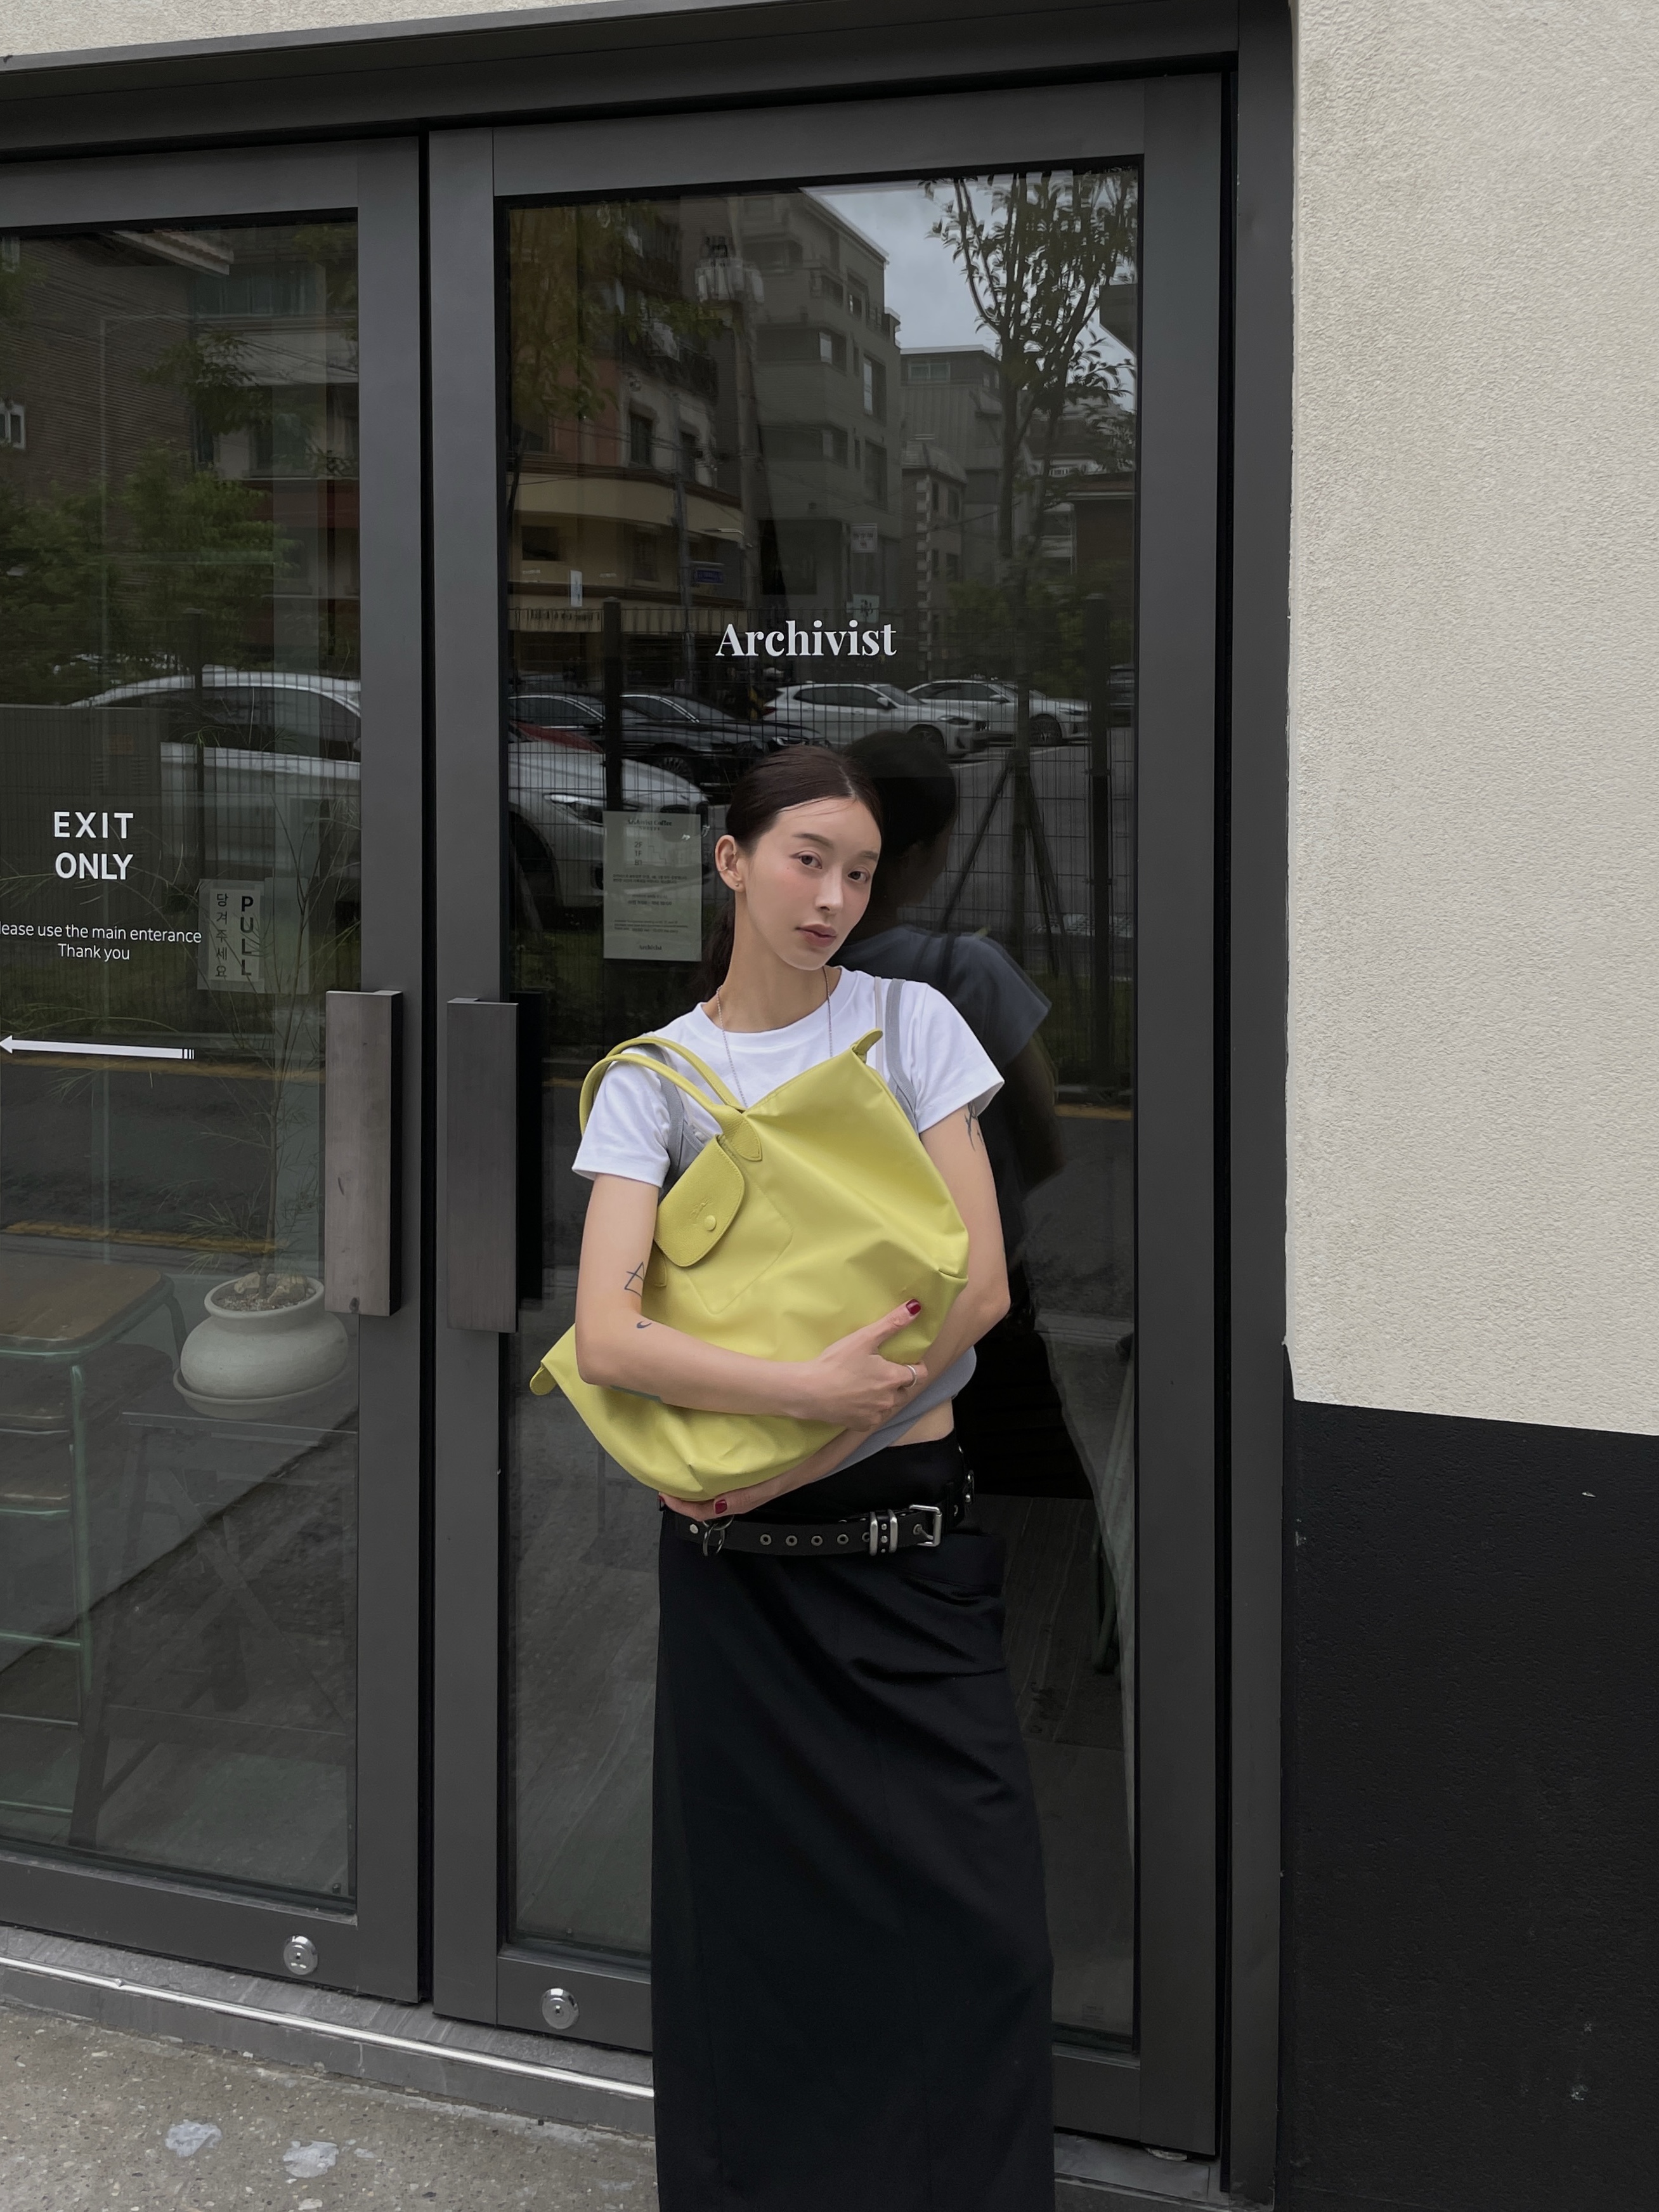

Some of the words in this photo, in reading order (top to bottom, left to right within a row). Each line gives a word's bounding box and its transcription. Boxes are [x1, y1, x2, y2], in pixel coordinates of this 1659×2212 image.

[715, 620, 897, 657] Archivist
[53, 811, 134, 839] EXIT
[55, 852, 133, 880] ONLY
[37, 926, 63, 937] use
[65, 924, 89, 939] the
[92, 926, 126, 940] main
[130, 927, 202, 943] enterance
[214, 893, 229, 978] 당겨주세요
[240, 895, 254, 976] PULL
[58, 943, 101, 959] Thank
[103, 948, 130, 962] you
